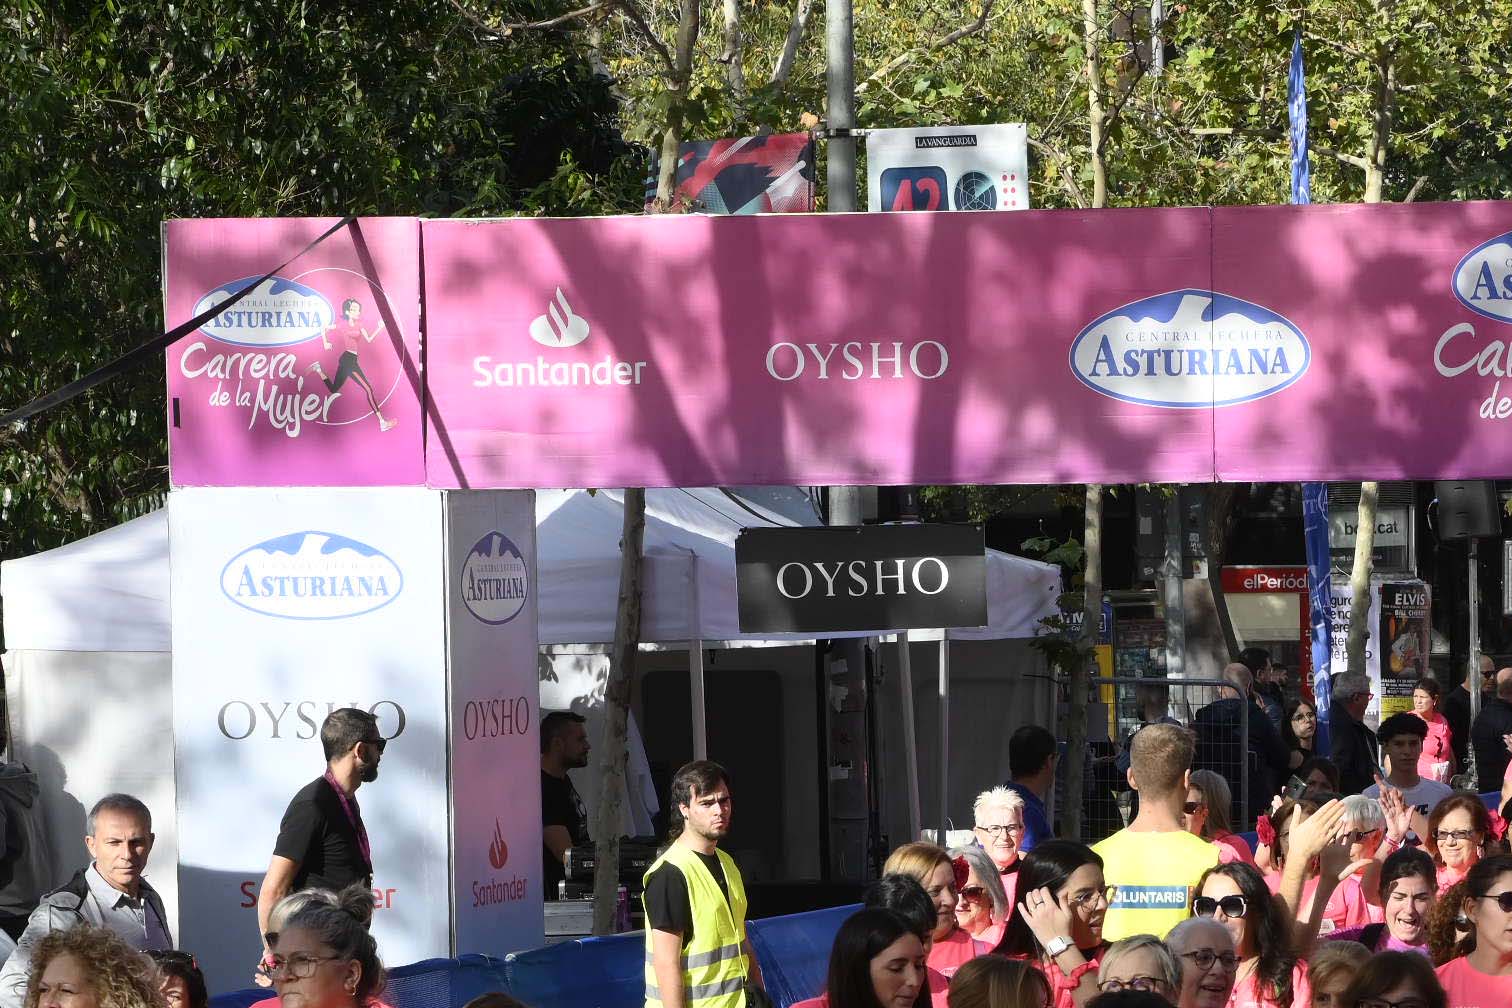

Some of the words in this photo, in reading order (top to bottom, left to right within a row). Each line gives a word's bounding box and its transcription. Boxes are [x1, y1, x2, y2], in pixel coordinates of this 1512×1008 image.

[927, 135, 976, 147] VANGUARDIA
[1126, 331, 1200, 342] CENTRAL
[1209, 330, 1284, 341] LECHERA
[180, 341, 297, 378] Carrera
[473, 356, 646, 388] Santander
[766, 340, 949, 381] OYSHO
[1089, 334, 1292, 377] ASTURIANA
[209, 381, 231, 407] de
[236, 380, 250, 407] la
[249, 376, 342, 437] Mujer
[236, 564, 389, 597] ASTURIANA
[467, 567, 524, 601] ASTURIANA
[776, 557, 949, 599] OYSHO
[1244, 573, 1310, 590] elPeriód
[1395, 593, 1425, 605] ELVIS
[217, 701, 406, 741] OYSO
[464, 696, 529, 740] OYSHO
[473, 877, 527, 907] Santander
